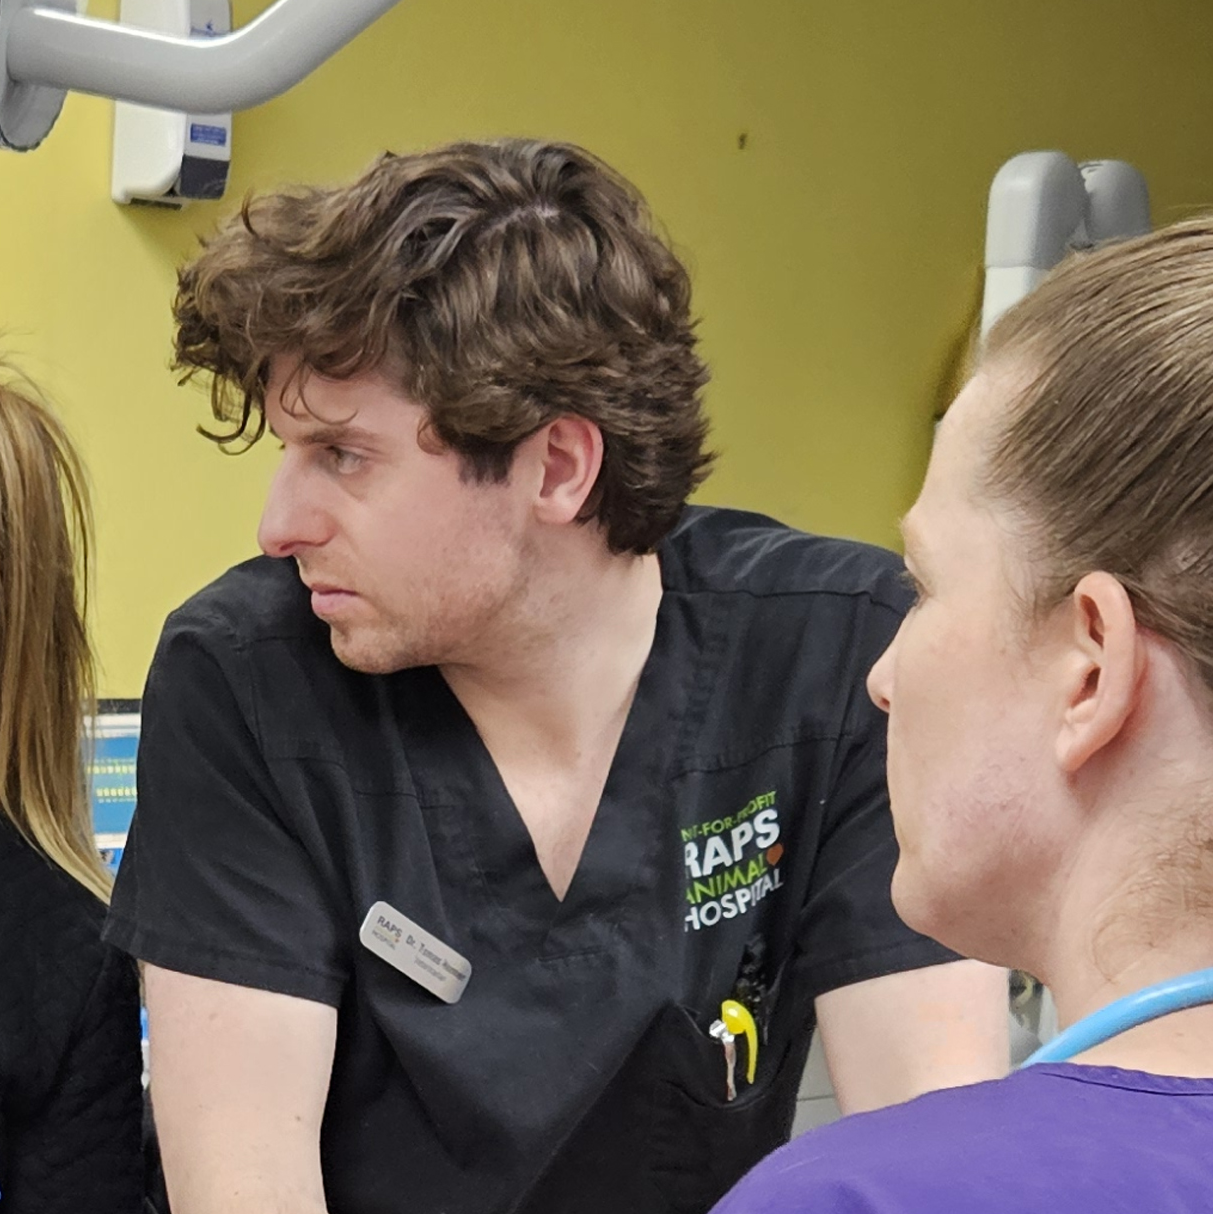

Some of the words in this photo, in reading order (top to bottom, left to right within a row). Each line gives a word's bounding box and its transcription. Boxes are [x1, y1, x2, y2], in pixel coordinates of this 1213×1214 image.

[684, 808, 780, 879] RAPS
[684, 868, 784, 933] HOSPITAL
[686, 853, 768, 905] ANIMAL
[377, 915, 403, 938] RAPS
